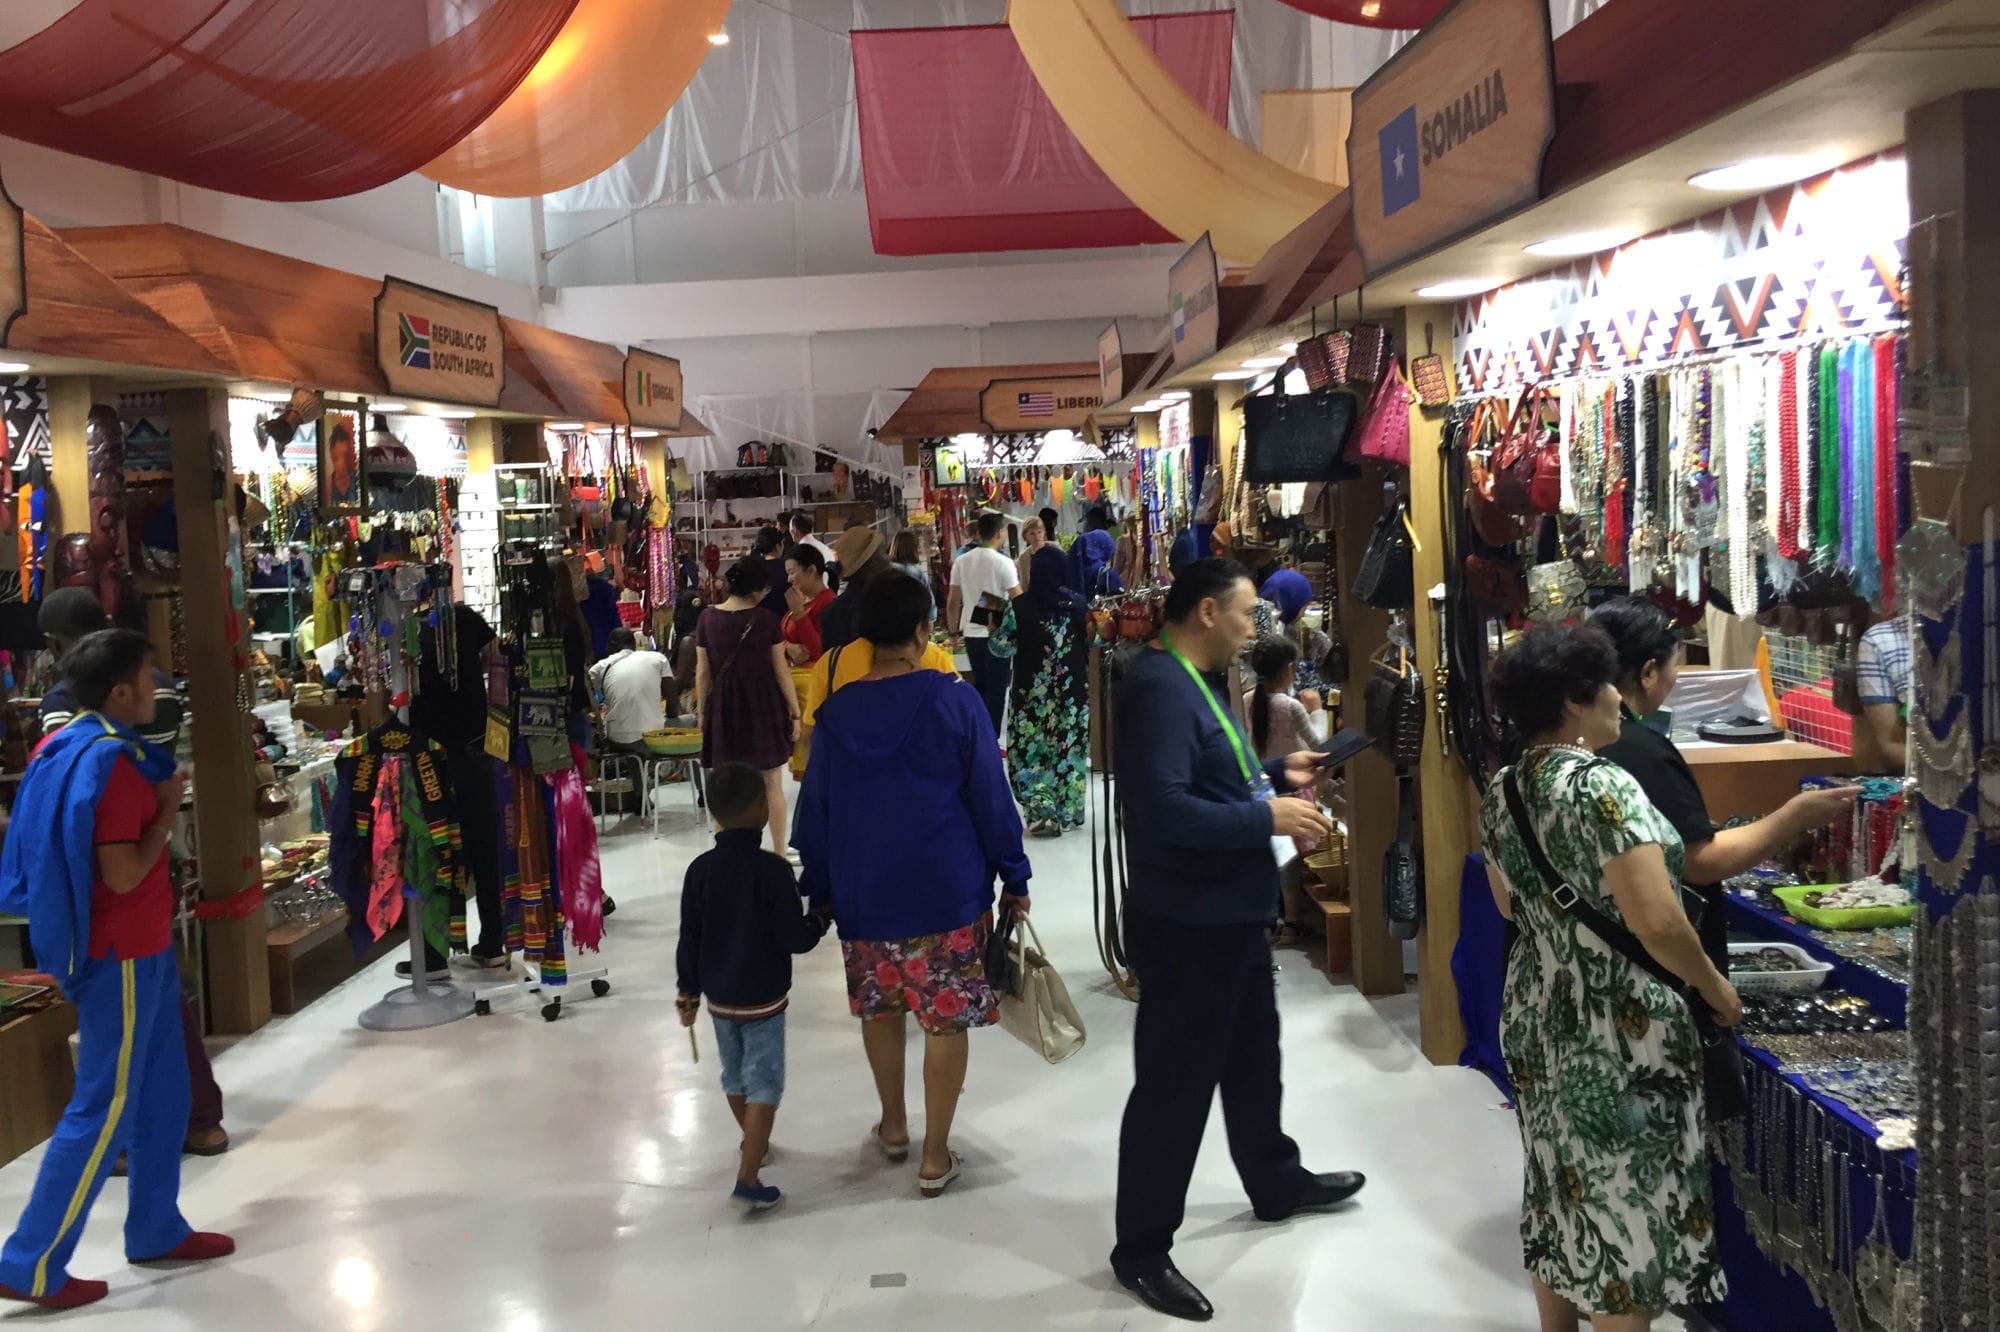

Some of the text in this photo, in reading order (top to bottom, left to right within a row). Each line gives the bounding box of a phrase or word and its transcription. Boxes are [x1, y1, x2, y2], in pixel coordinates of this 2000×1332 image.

[1421, 68, 1508, 167] SOMALIA
[432, 324, 487, 352] REPUBLIC OF
[433, 350, 494, 378] SOUTH AFRICA
